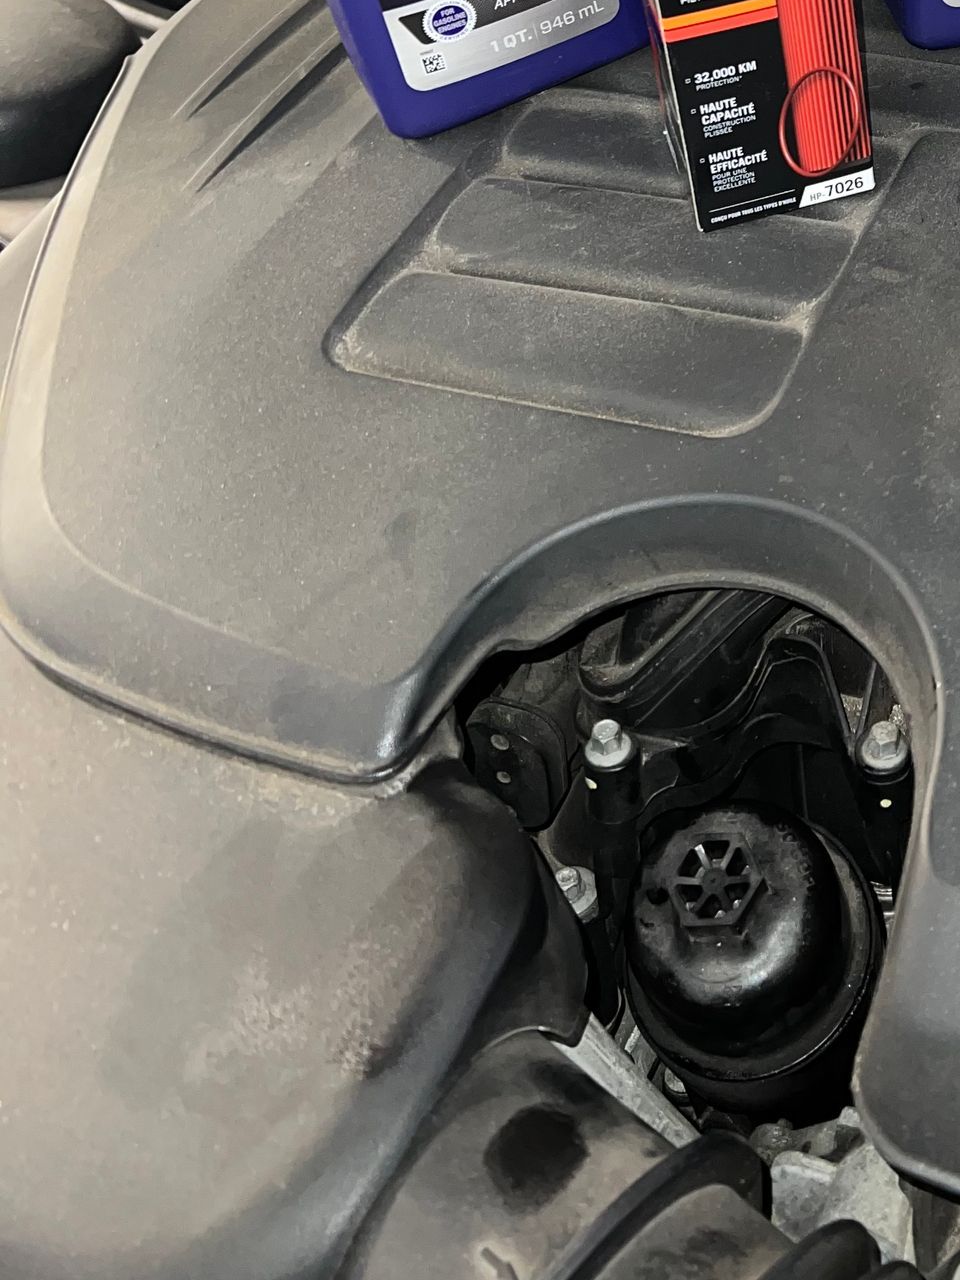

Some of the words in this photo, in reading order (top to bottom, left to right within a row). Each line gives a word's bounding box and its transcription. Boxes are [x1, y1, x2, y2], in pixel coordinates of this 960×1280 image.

[433, 11, 466, 28] GASOLINE
[440, 7, 455, 17] FOR
[437, 18, 466, 34] ENGINES
[490, 40, 499, 53] 1
[504, 29, 533, 48] QT.
[540, 11, 575, 34] 946
[578, 0, 605, 19] mL
[694, 65, 736, 84] 32,000
[738, 60, 757, 74] KM
[700, 97, 737, 115] HAUTE
[701, 101, 756, 125] CAPACITÉ
[703, 114, 756, 132] CONSTRUCTION
[708, 146, 744, 164] HAUTE
[710, 149, 768, 174] EFFICACITÉ
[712, 171, 731, 181] POUR
[733, 167, 747, 176] UNE
[713, 171, 755, 186] PROTECTION
[714, 177, 756, 193] EXCELLENTE
[809, 176, 864, 202] HP-7026
[742, 207, 754, 216] TOUS
[763, 201, 778, 210] TYPES
